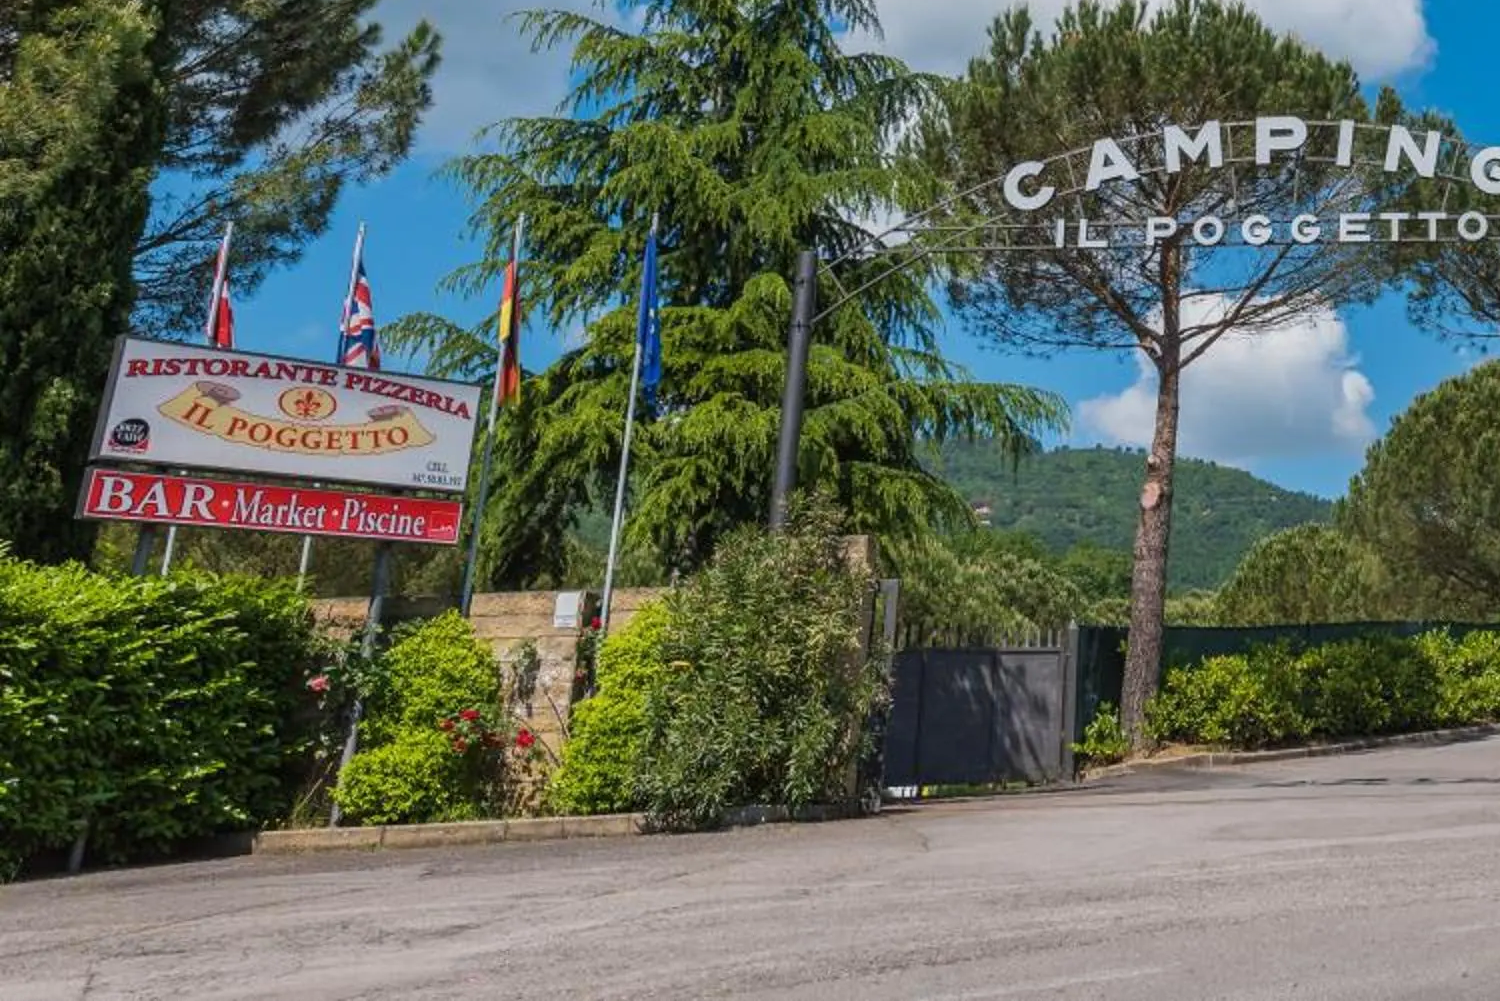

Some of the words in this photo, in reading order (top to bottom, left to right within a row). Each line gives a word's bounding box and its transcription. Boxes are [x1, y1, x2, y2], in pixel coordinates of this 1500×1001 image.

[1055, 217, 1108, 248] IL
[1145, 209, 1489, 248] POGGETTO
[125, 357, 339, 386] RISTORANTE
[344, 371, 472, 421] PIZZERIA
[181, 400, 217, 431] IL
[225, 415, 409, 451] POGGETTO
[93, 475, 216, 520] BAR
[230, 488, 327, 529] Market
[339, 498, 426, 536] Piscine
